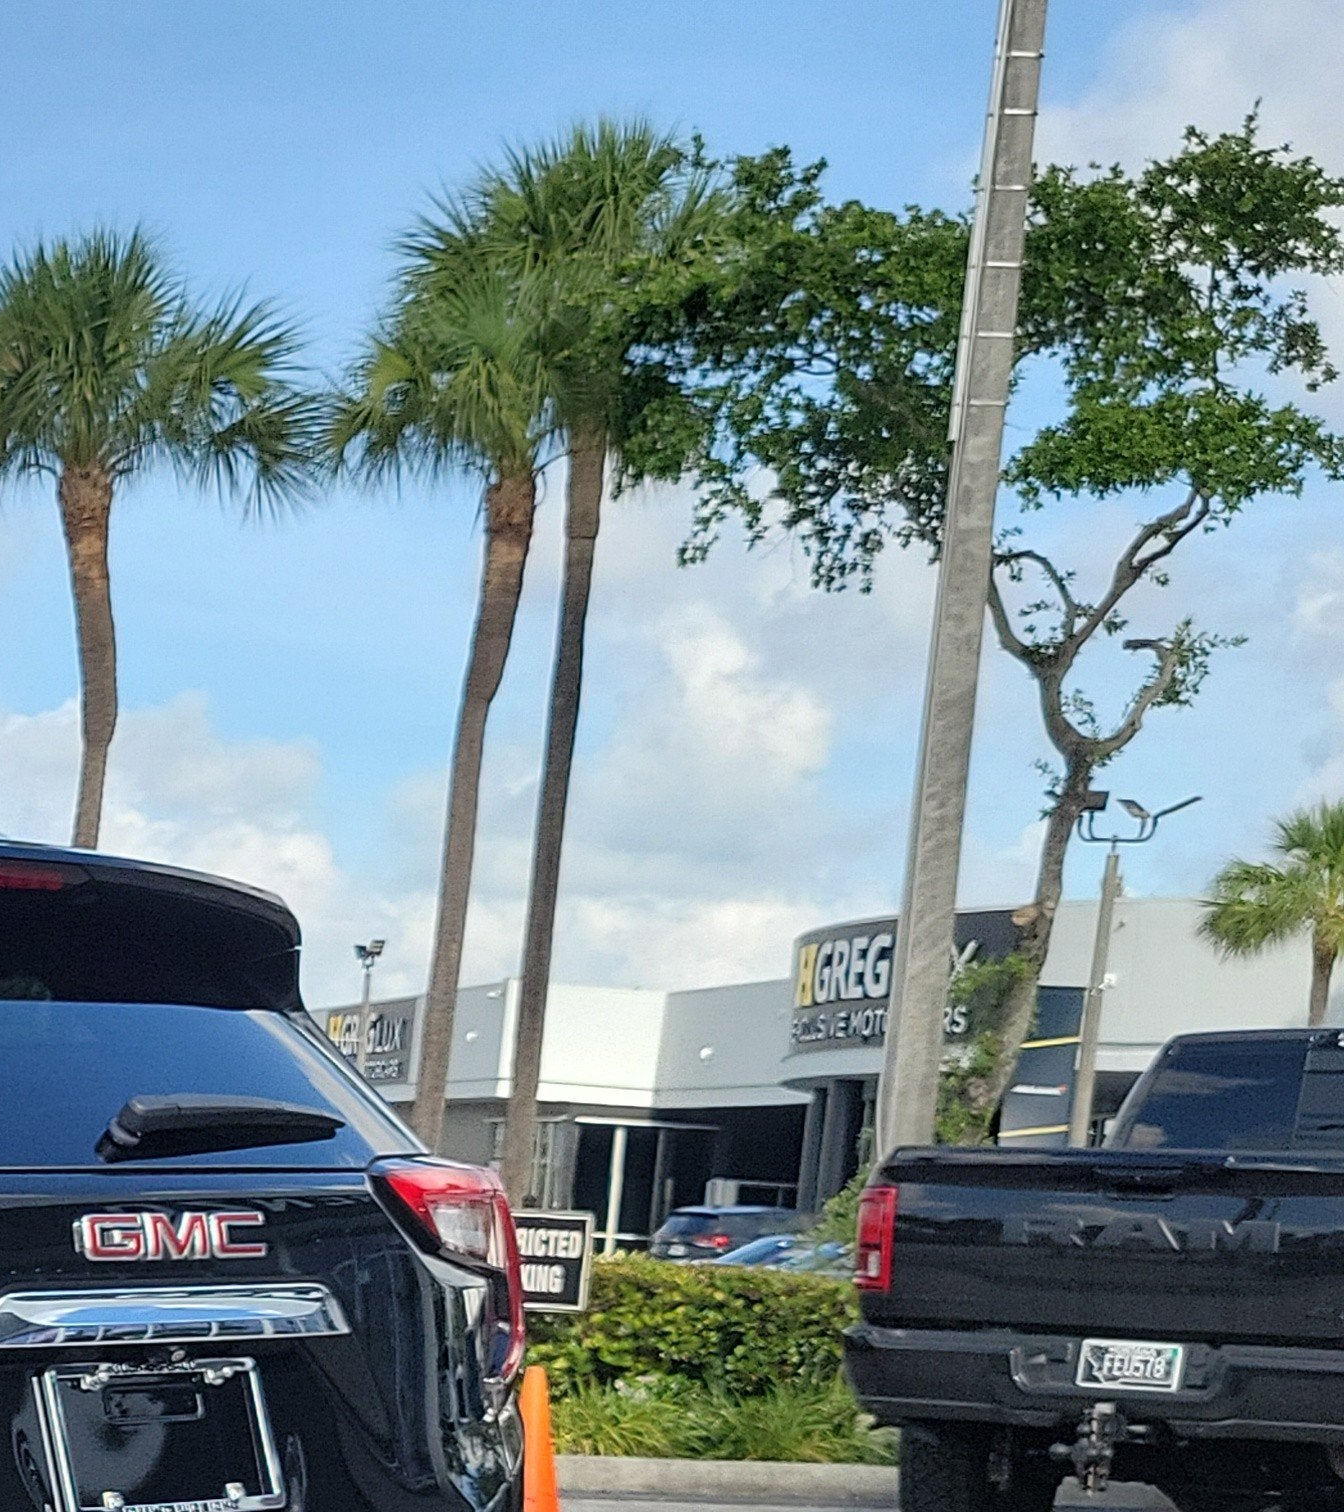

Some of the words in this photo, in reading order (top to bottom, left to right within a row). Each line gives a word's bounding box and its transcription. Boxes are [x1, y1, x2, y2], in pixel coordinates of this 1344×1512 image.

[80, 1211, 268, 1262] GMC
[515, 1228, 583, 1259] RICTED
[1003, 1212, 1280, 1252] RAM
[519, 1262, 566, 1293] KING
